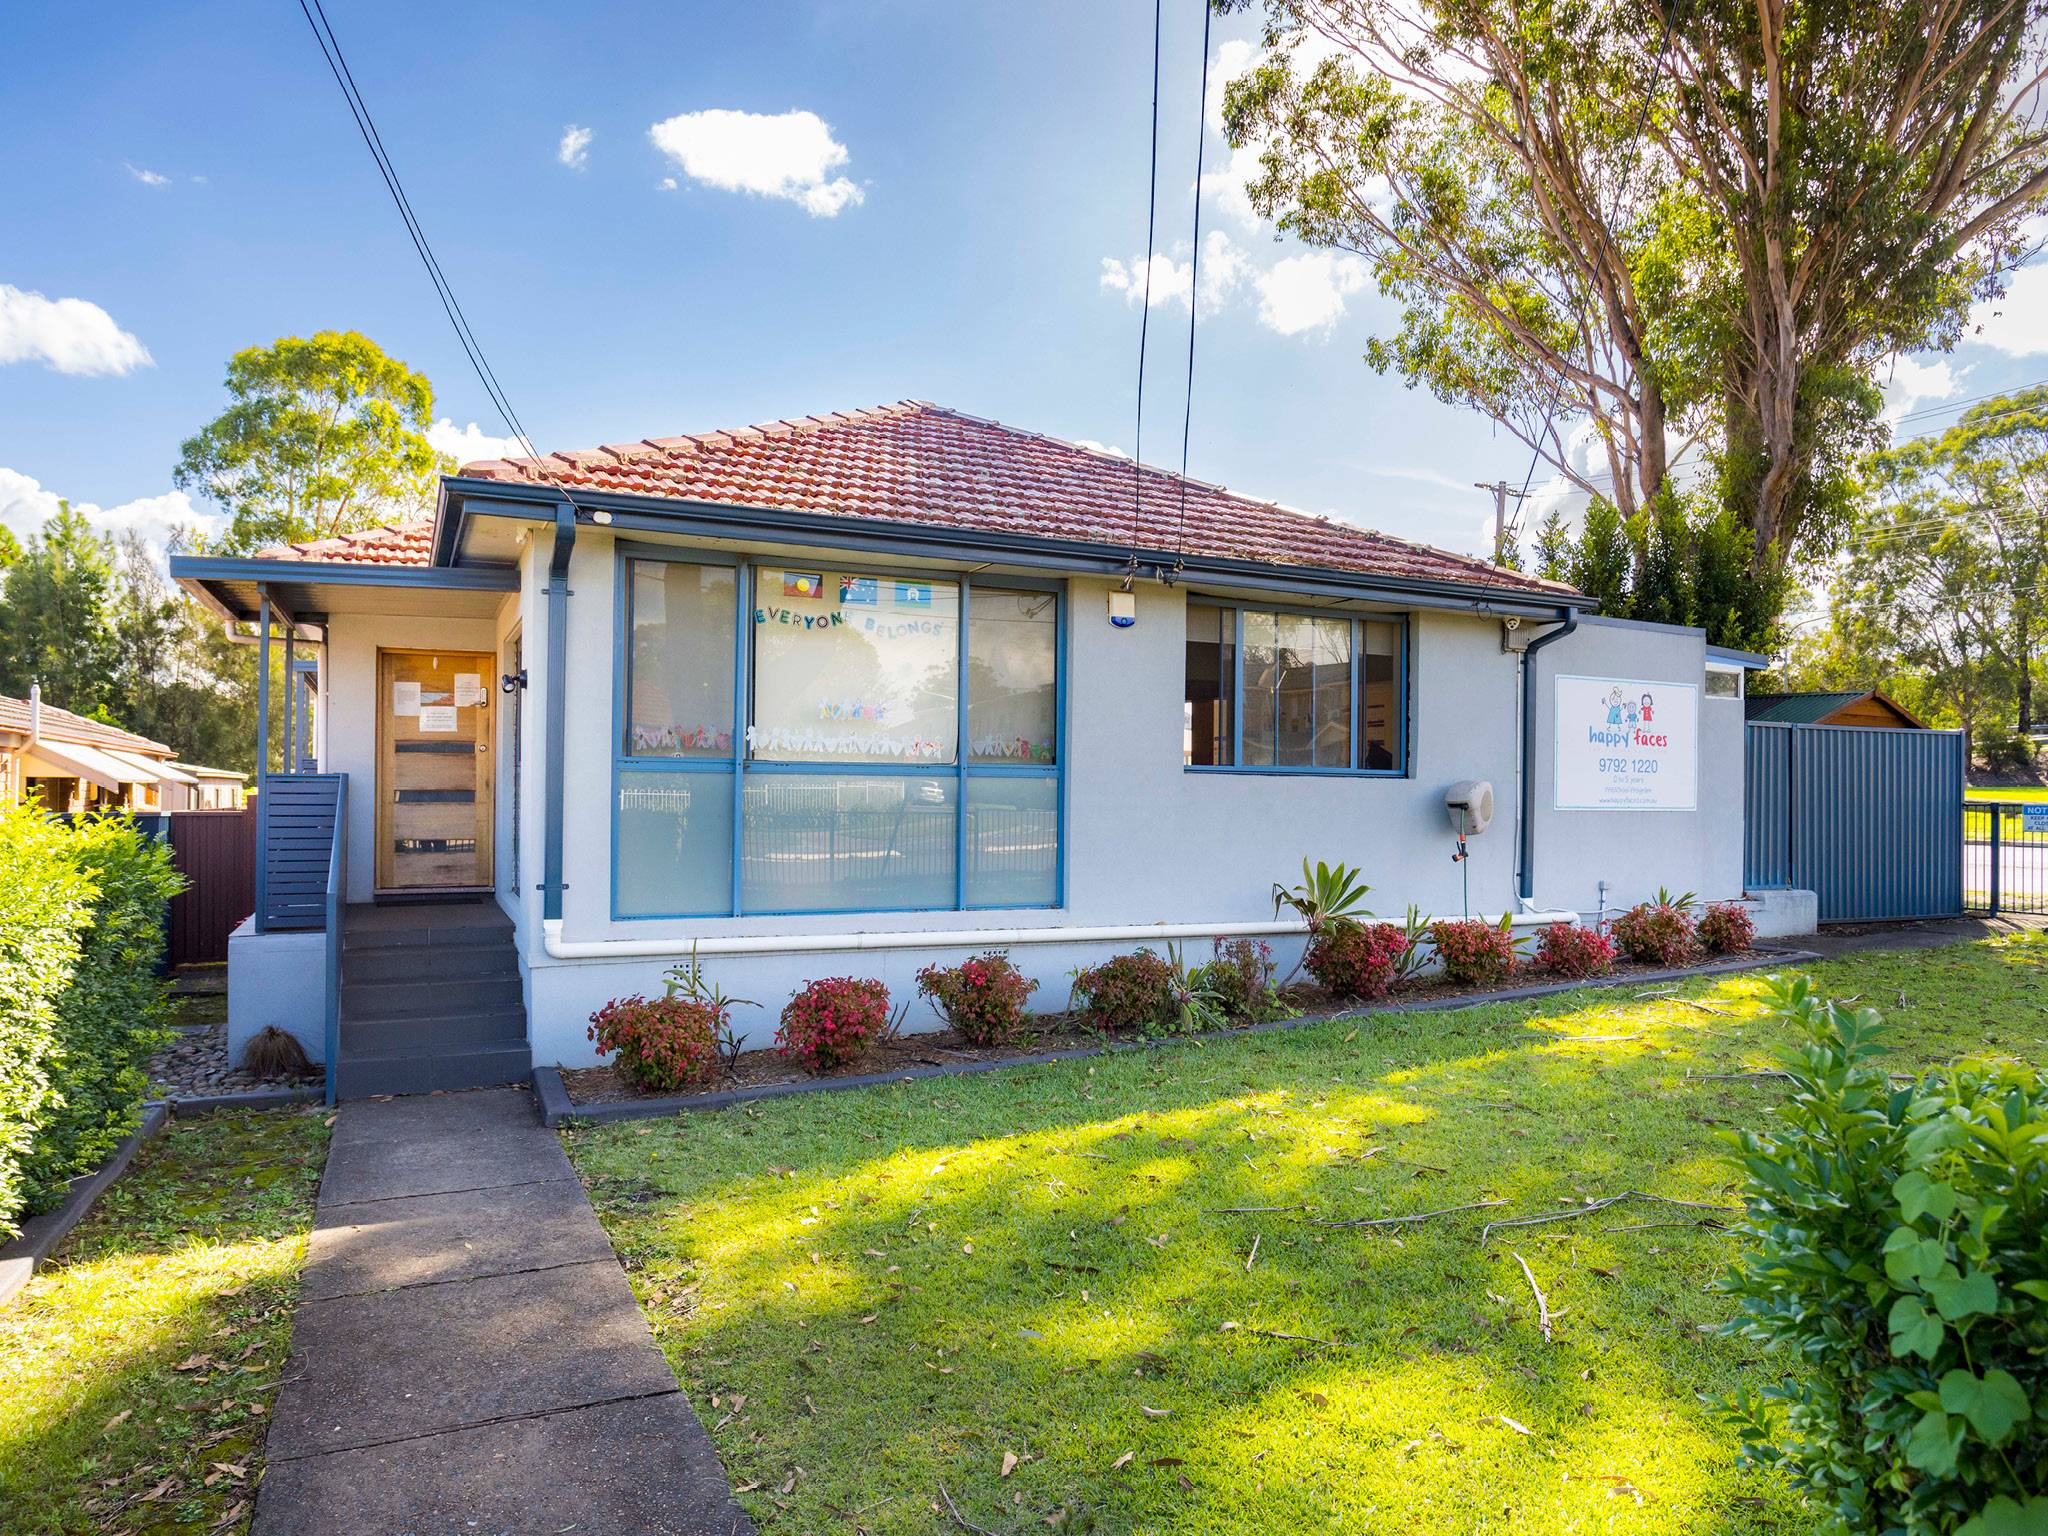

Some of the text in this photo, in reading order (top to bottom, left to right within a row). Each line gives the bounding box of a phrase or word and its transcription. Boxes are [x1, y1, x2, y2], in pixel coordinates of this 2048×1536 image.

[864, 617, 943, 640] BELONGS
[1589, 727, 1668, 747] happy faces
[1599, 758, 1658, 774] 9792 1220
